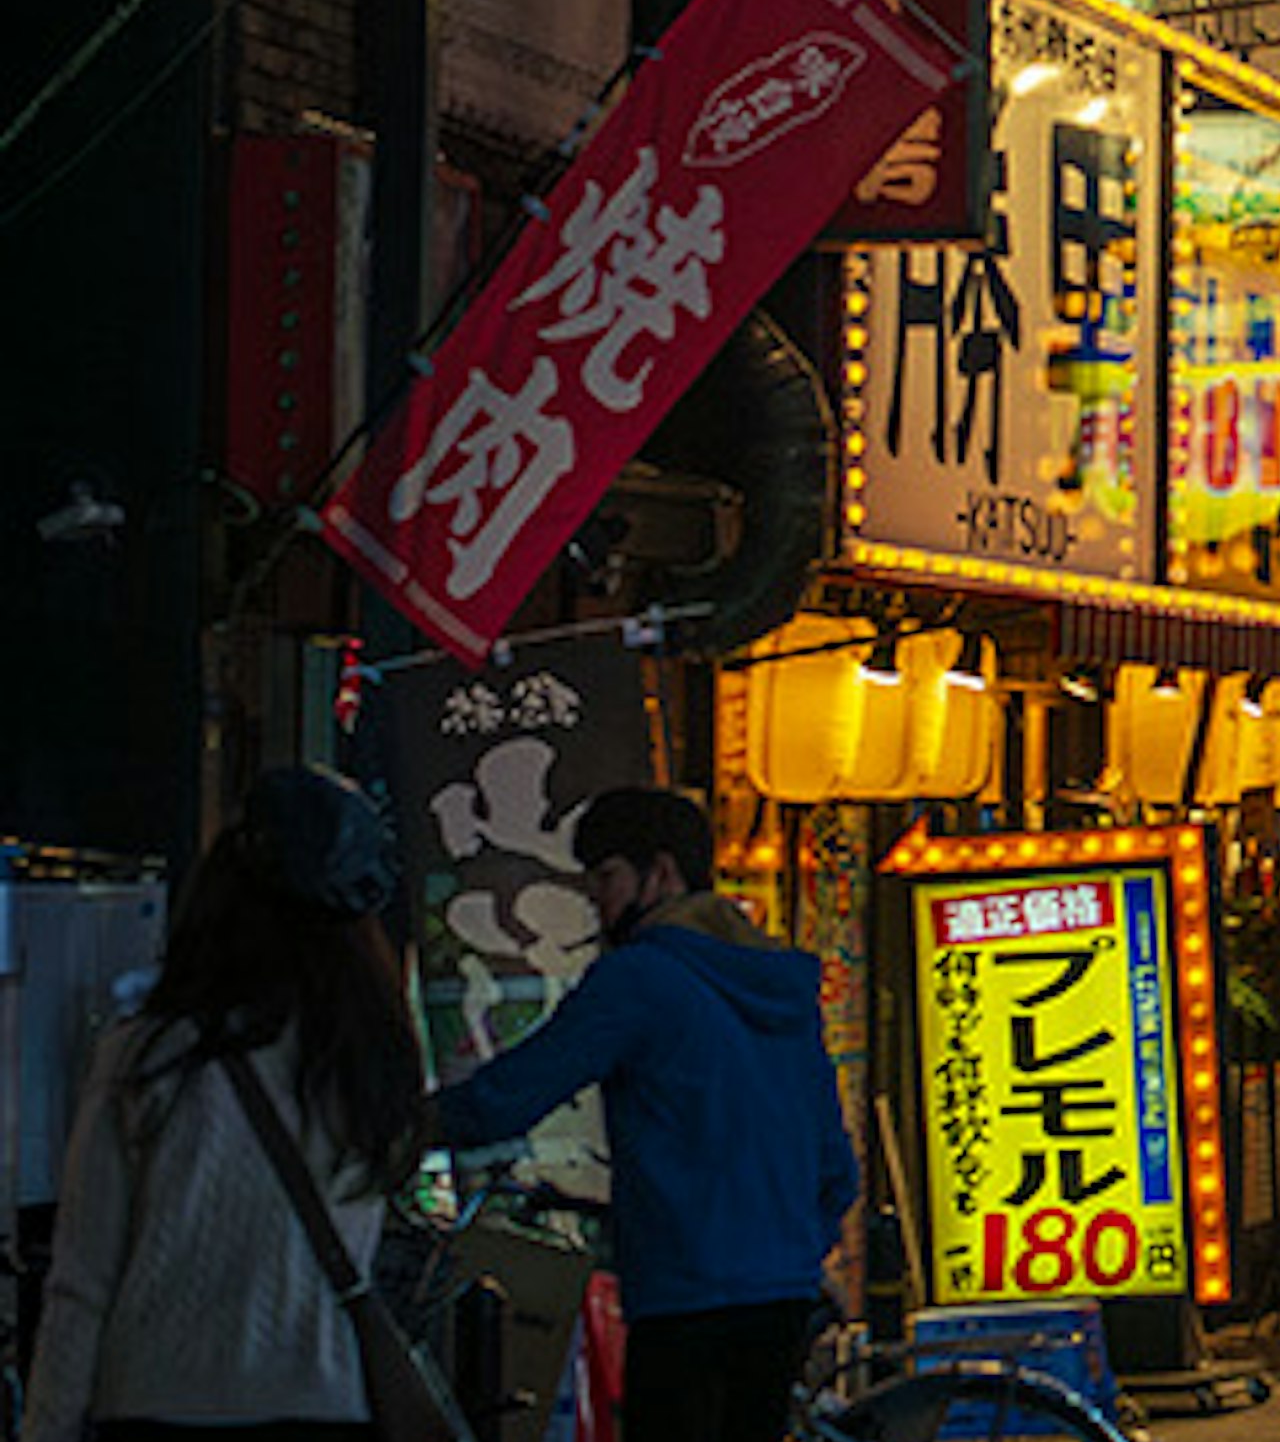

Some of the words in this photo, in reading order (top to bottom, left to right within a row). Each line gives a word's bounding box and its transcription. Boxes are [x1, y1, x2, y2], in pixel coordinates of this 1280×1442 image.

[389, 145, 726, 601] 焼肉
[993, 934, 1127, 1206] プレモル
[982, 1207, 1181, 1295] 180円
